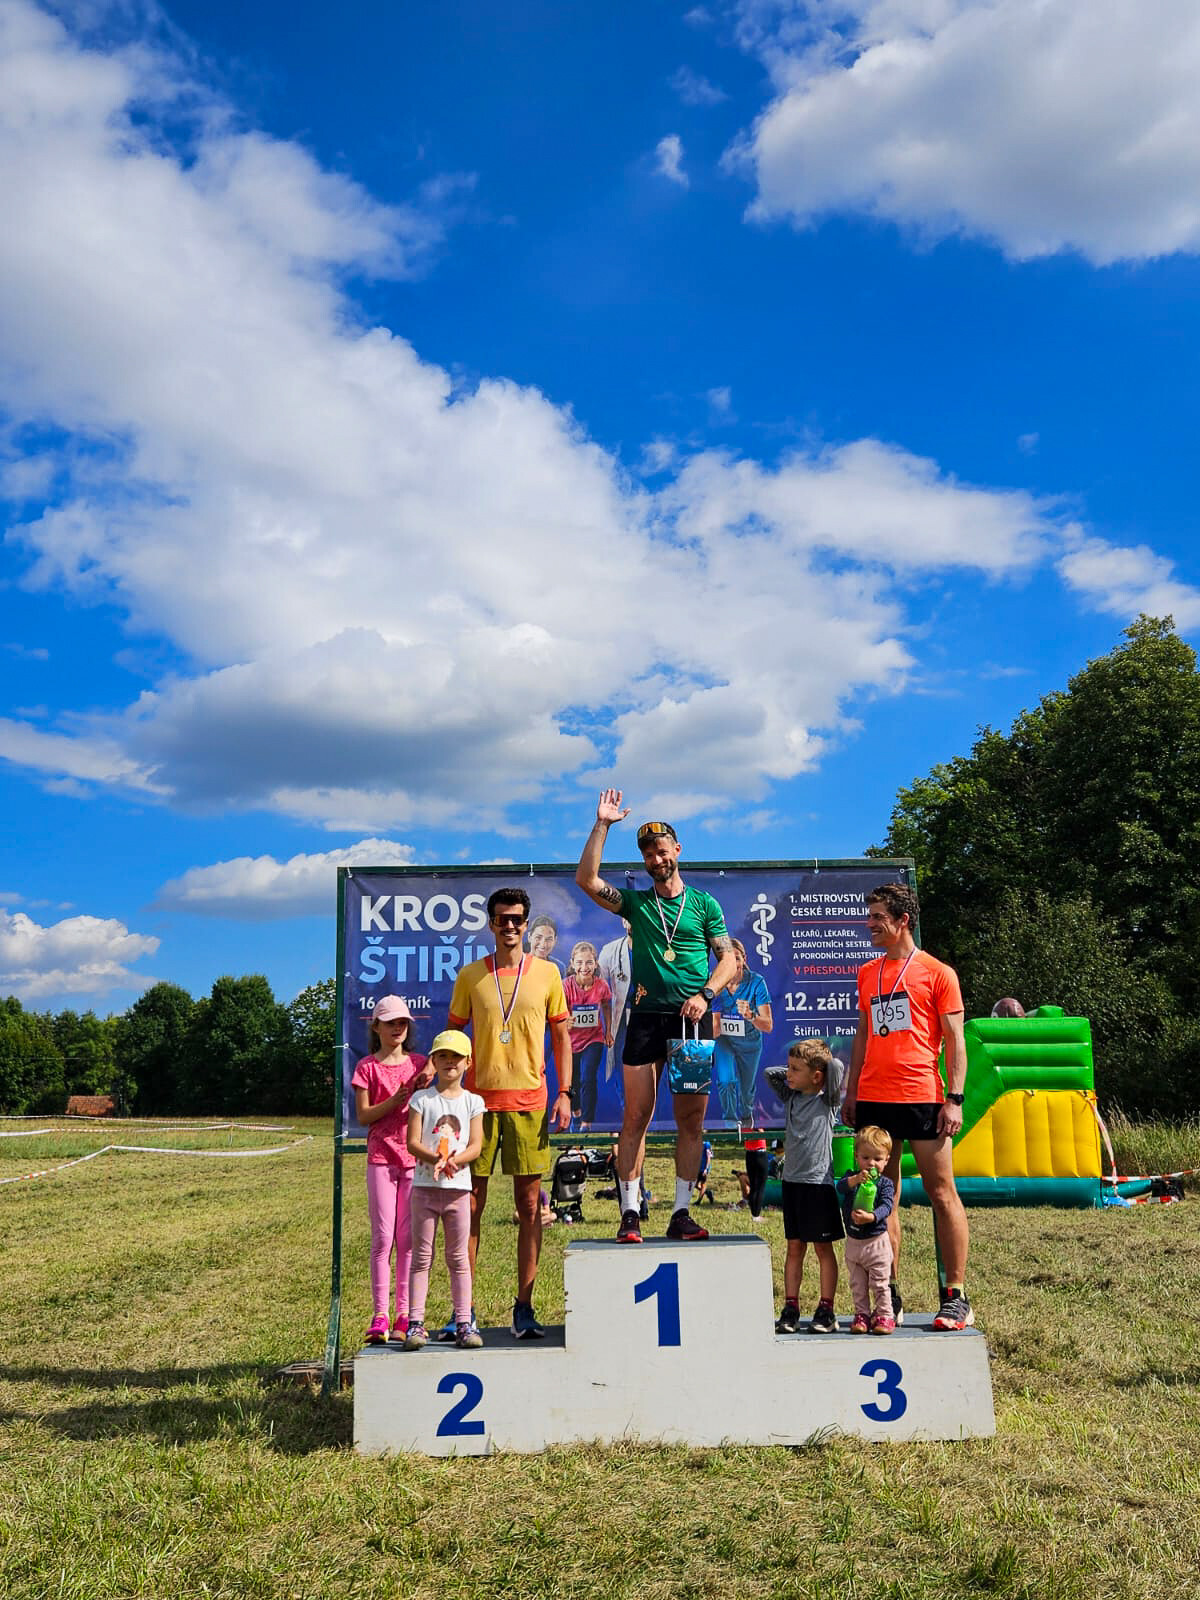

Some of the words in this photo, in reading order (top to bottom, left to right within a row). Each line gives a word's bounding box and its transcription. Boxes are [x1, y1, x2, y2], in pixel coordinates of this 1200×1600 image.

[790, 894, 798, 904] 1.
[800, 892, 865, 903] MISTROVSTVÍ
[360, 894, 487, 932] KROS
[790, 905, 823, 917] ČESKÉ
[825, 907, 870, 917] REPUBLIK
[823, 928, 858, 939] LÉKAŘEK,
[792, 939, 844, 949] ZDRAVOTNÍCH
[845, 940, 872, 949] SESTER
[359, 935, 497, 983] ŠTIŘÍ
[793, 952, 799, 960] A
[800, 950, 844, 960] PORODNÍCH
[793, 966, 801, 975] V
[803, 963, 858, 975] PŘESPOLNÍ
[359, 996, 376, 1010] 16
[784, 991, 814, 1012] 12.
[816, 992, 852, 1011] září
[576, 1014, 595, 1024] 103
[876, 1005, 906, 1024] 095
[722, 1022, 740, 1033] 101
[794, 1024, 821, 1037] Štiřín
[835, 1025, 857, 1036] Prah
[634, 1262, 682, 1347] 1
[860, 1358, 908, 1423] 3
[436, 1372, 485, 1437] 2
